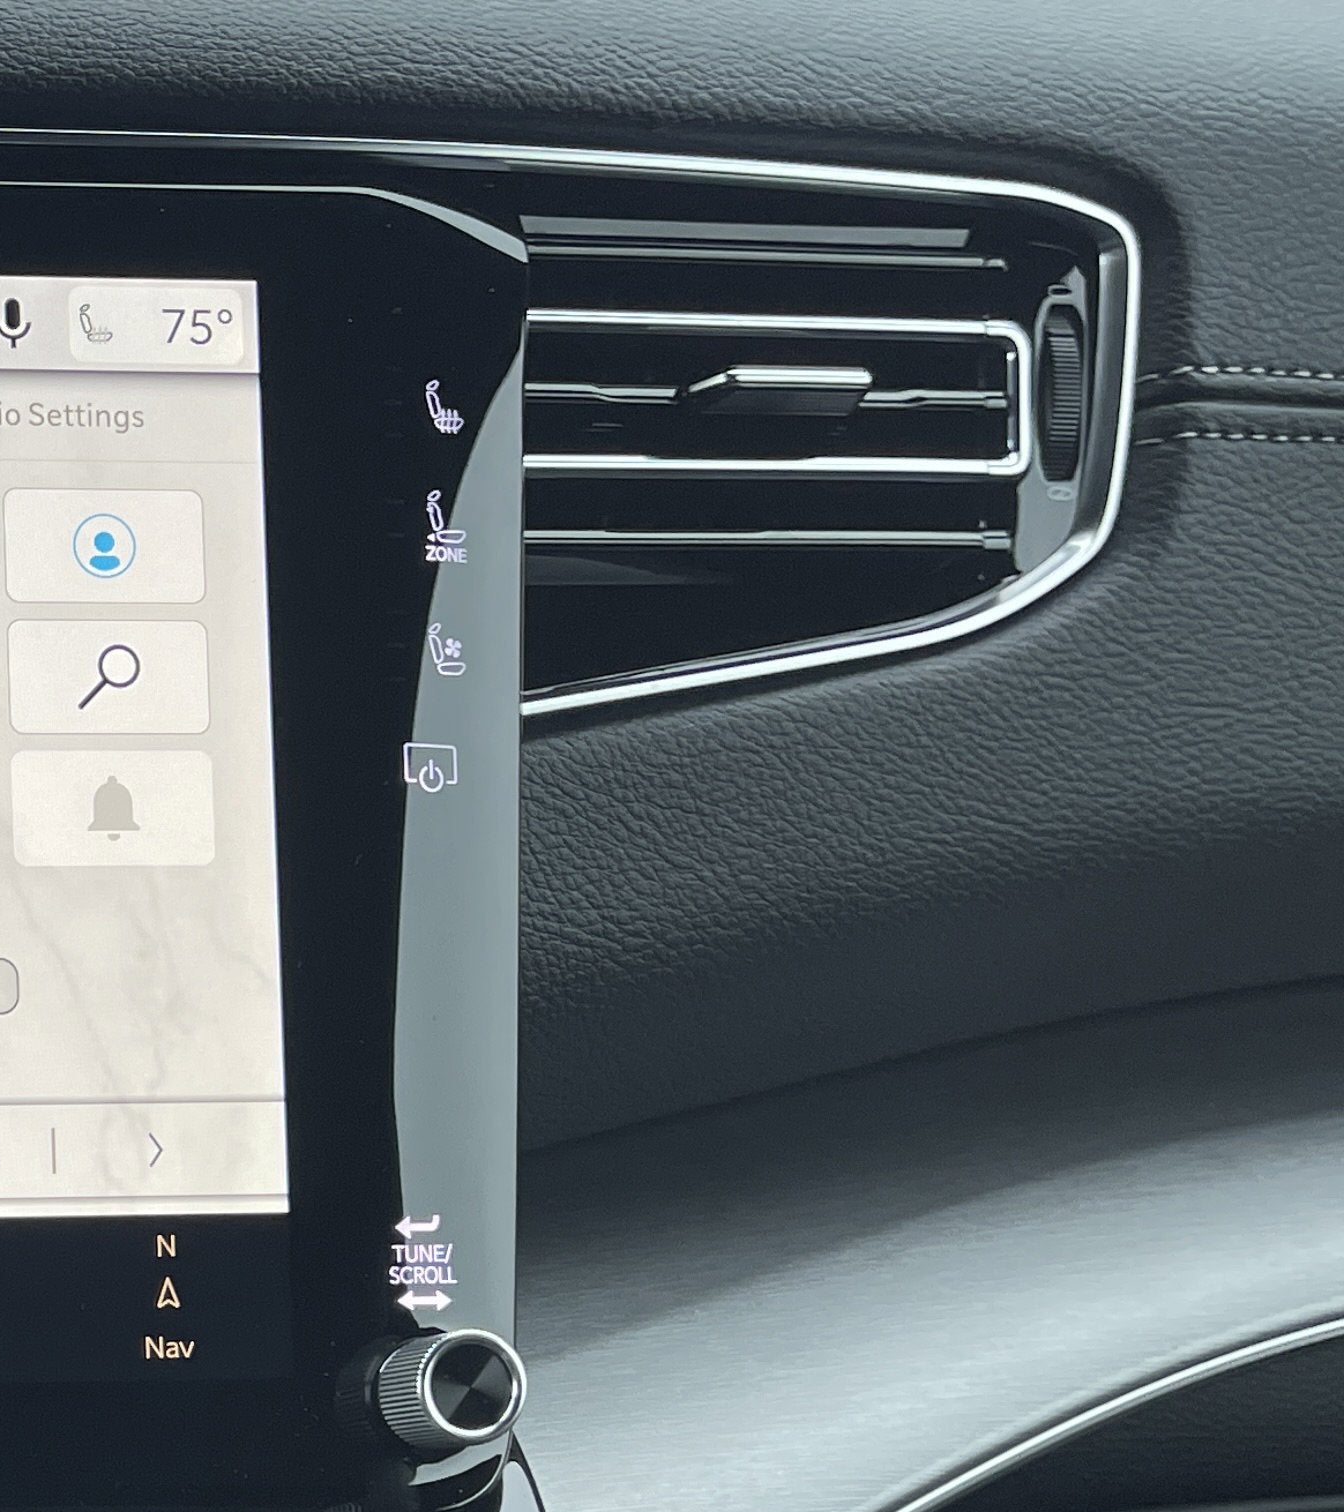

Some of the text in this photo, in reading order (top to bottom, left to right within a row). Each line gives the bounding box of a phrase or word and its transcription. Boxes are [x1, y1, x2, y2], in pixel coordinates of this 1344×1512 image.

[161, 308, 234, 347] 75°
[28, 401, 146, 435] Settings
[425, 545, 468, 564] ZONE
[157, 1235, 176, 1258] N
[391, 1243, 453, 1264] TUNE/
[389, 1266, 458, 1284] SCROLL
[145, 1337, 194, 1360] Nav
